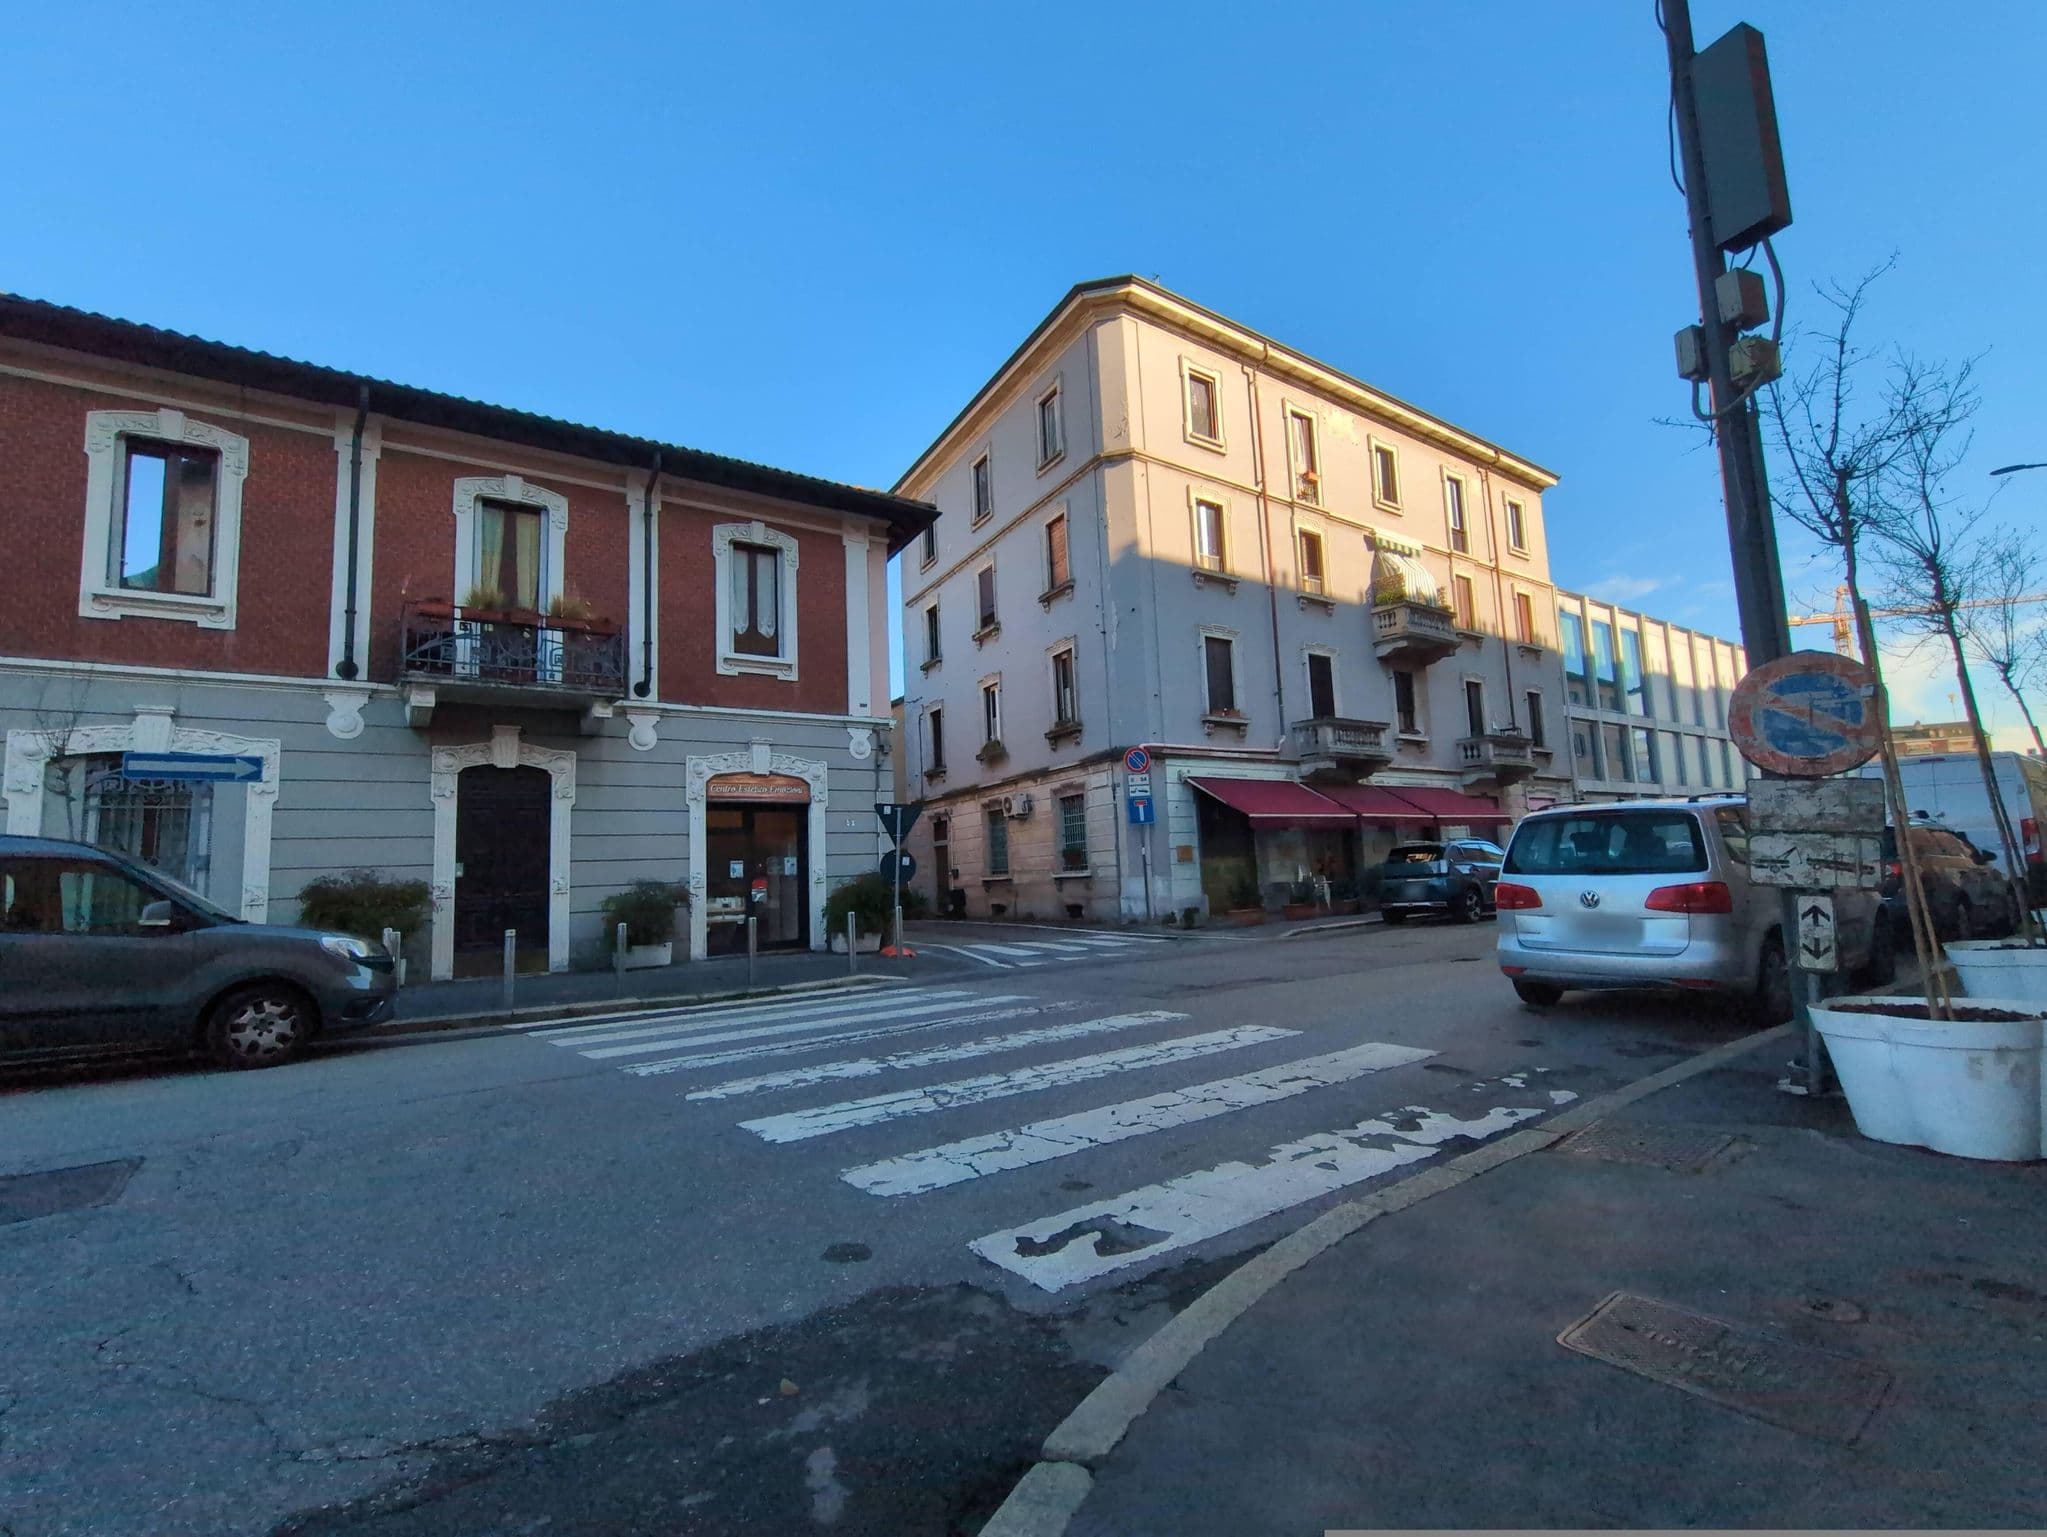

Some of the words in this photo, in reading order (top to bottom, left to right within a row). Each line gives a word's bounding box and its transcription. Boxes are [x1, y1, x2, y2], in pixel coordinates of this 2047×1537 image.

[710, 784, 736, 793] Centro
[738, 784, 768, 794] Estetico
[1580, 890, 1600, 909] VW
